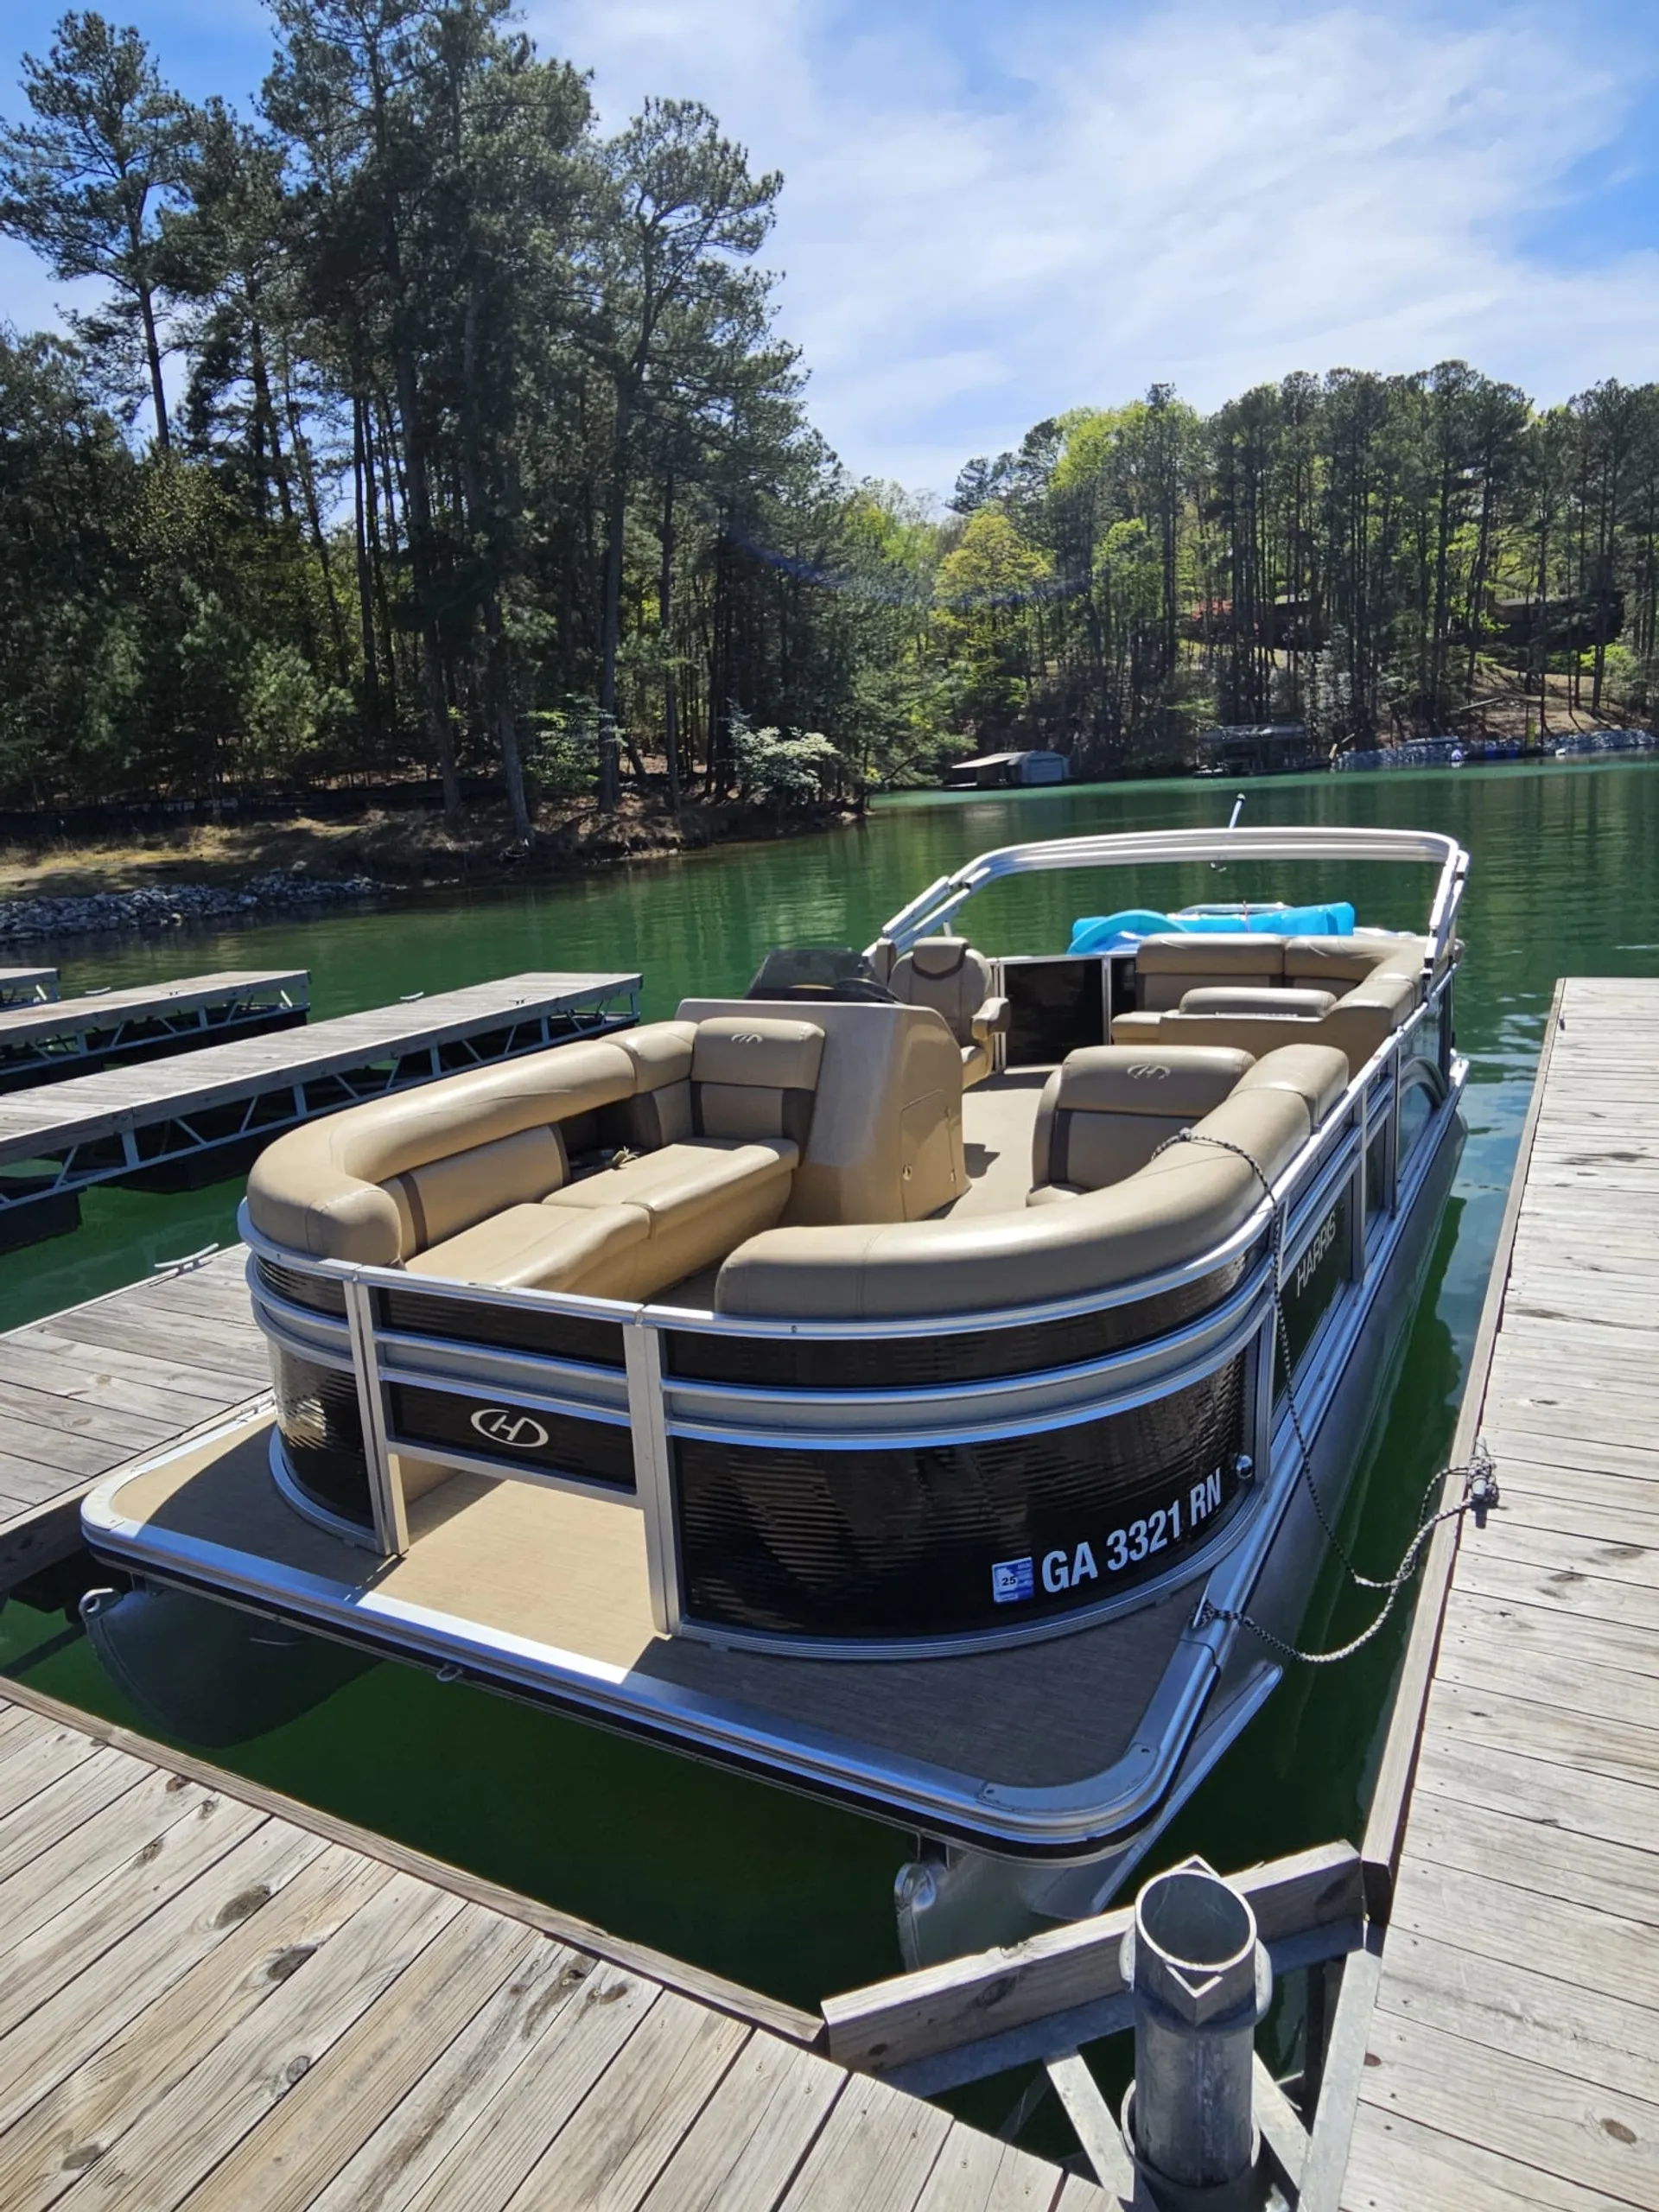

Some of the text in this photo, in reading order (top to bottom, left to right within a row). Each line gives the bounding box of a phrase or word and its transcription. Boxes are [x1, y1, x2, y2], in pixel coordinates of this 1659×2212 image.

[1297, 1210, 1336, 1298] HARRIS
[1041, 1541, 1098, 1593] GA
[1106, 1500, 1181, 1571] 3321
[1190, 1468, 1221, 1526] RN
[1001, 1576, 1017, 1586] 25
